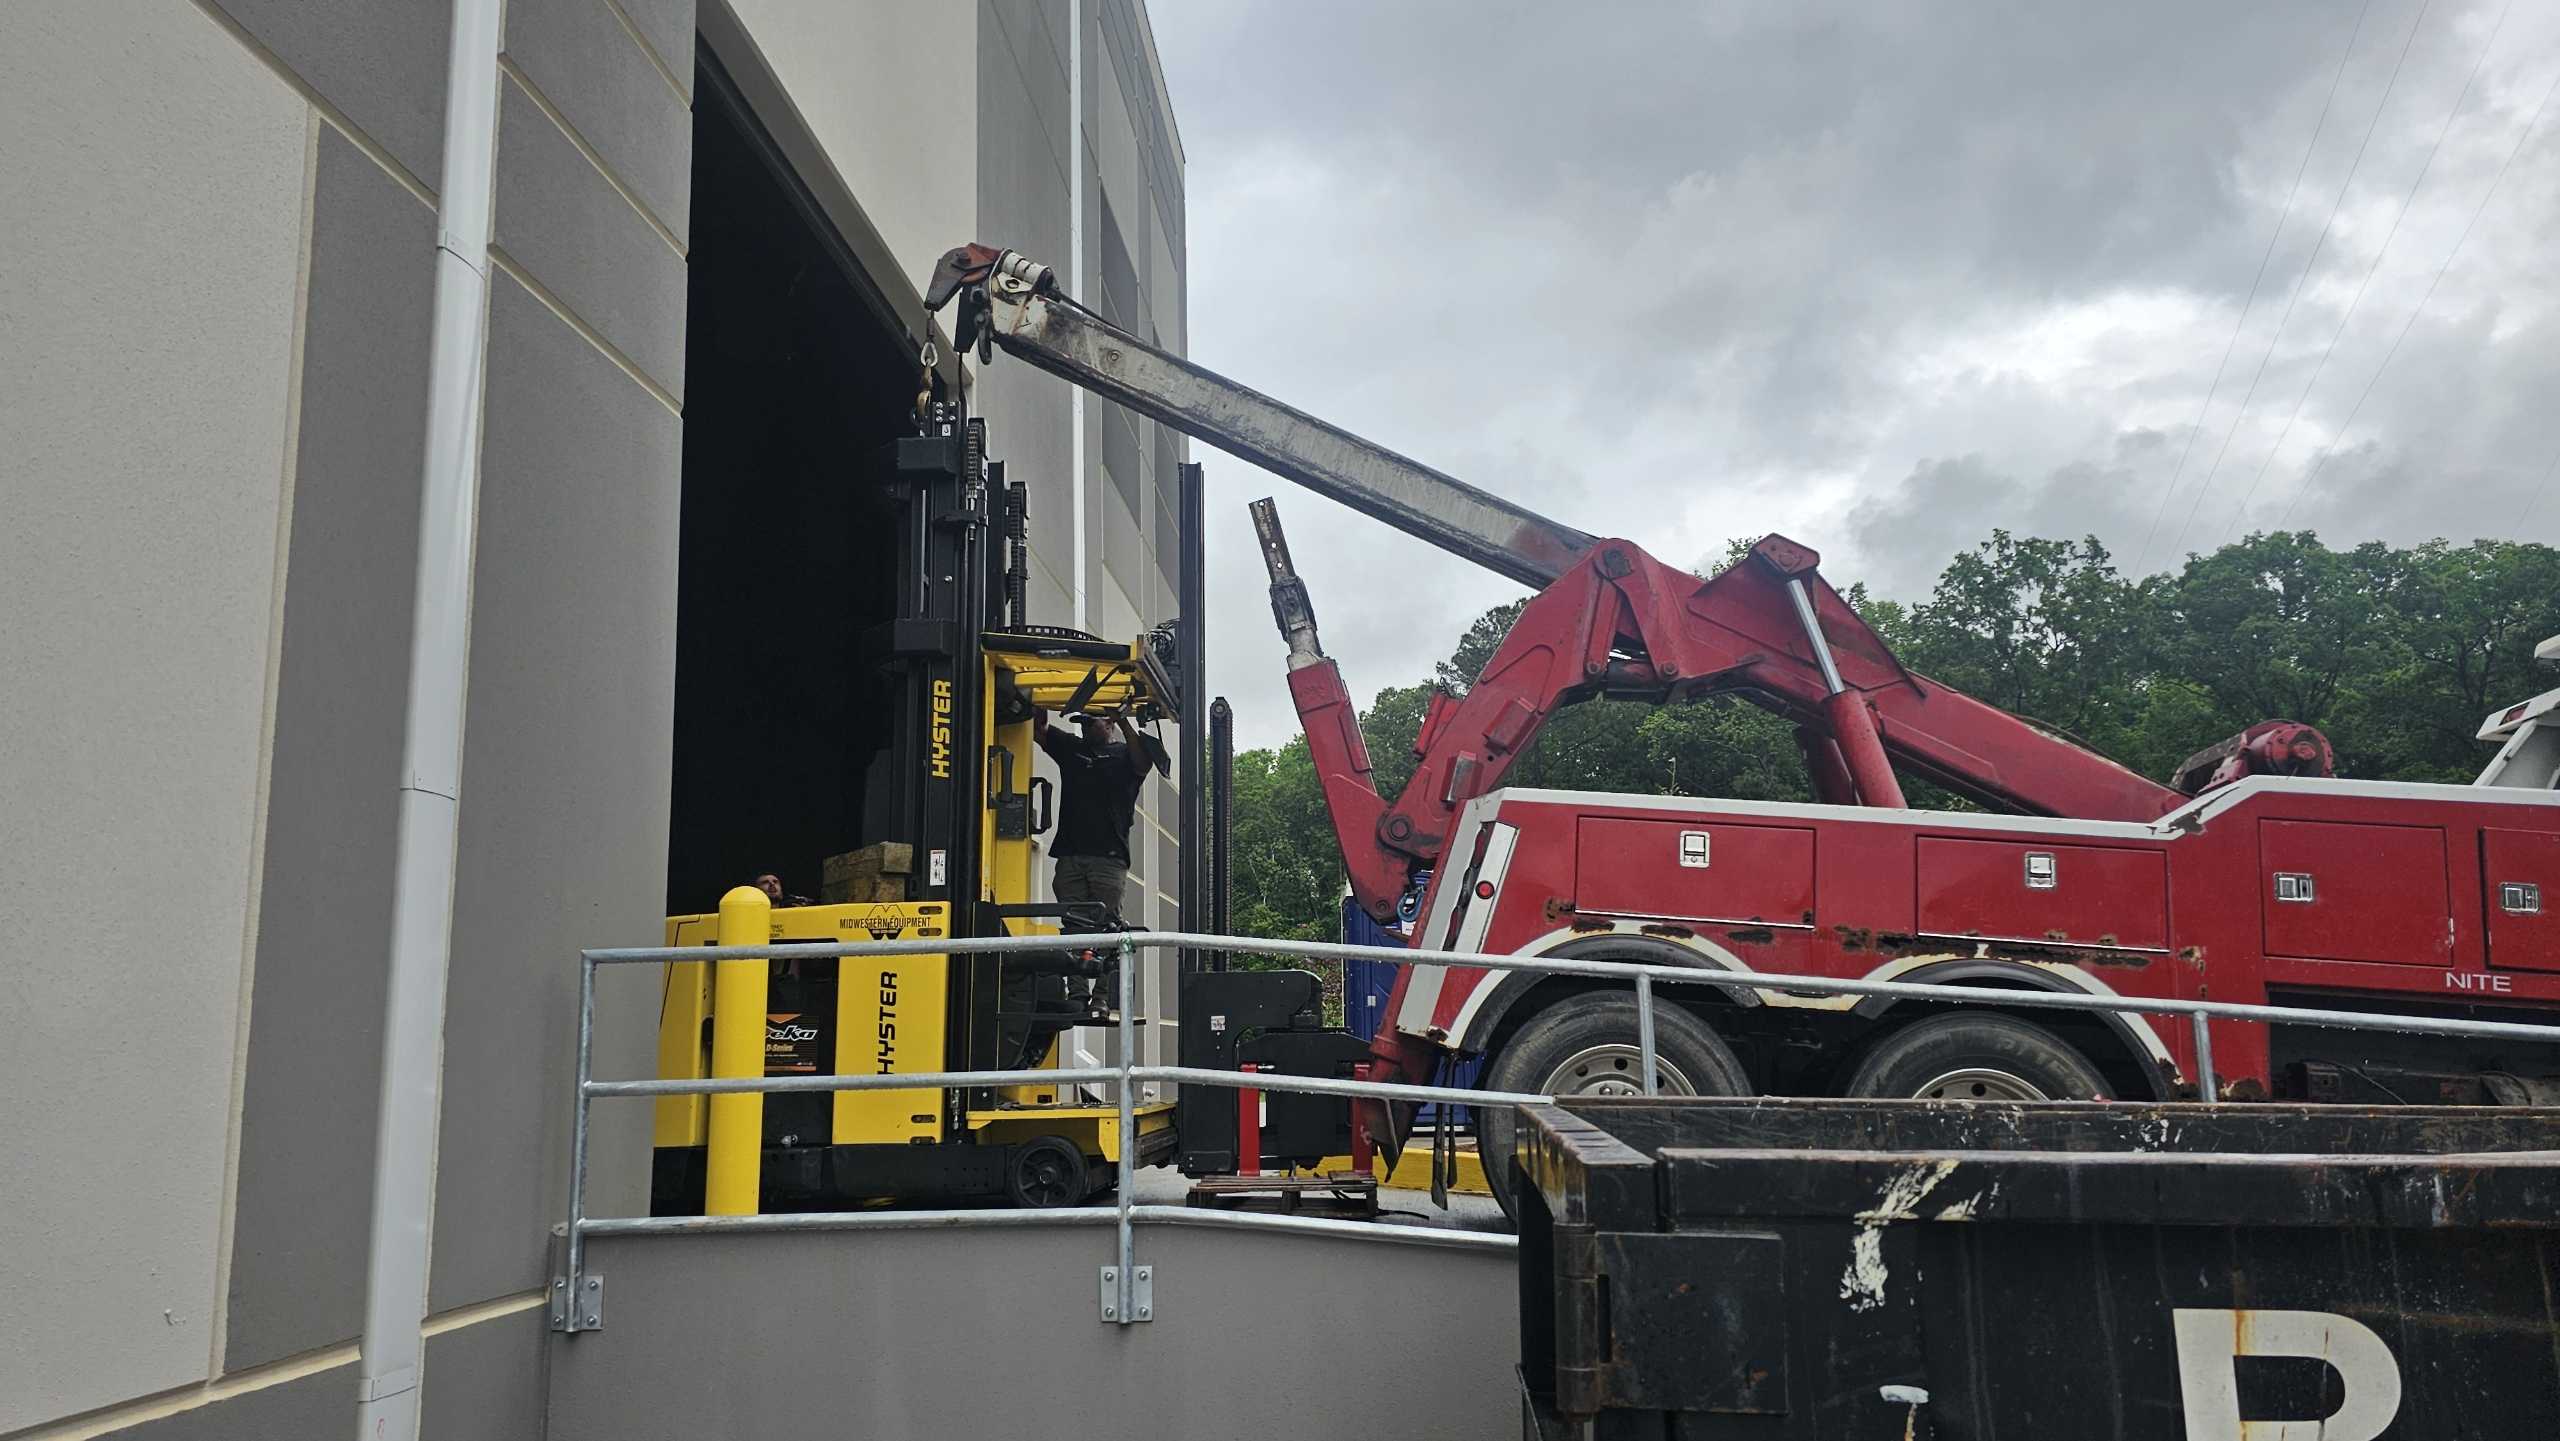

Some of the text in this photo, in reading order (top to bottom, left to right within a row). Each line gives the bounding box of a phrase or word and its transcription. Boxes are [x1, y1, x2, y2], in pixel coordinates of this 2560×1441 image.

[932, 679, 951, 778] HYSTER
[839, 916, 931, 929] MIDWESTERN EQUIPMENT
[2445, 971, 2513, 993] NITE
[766, 1024, 818, 1042] eka
[877, 971, 898, 1075] HYSTER
